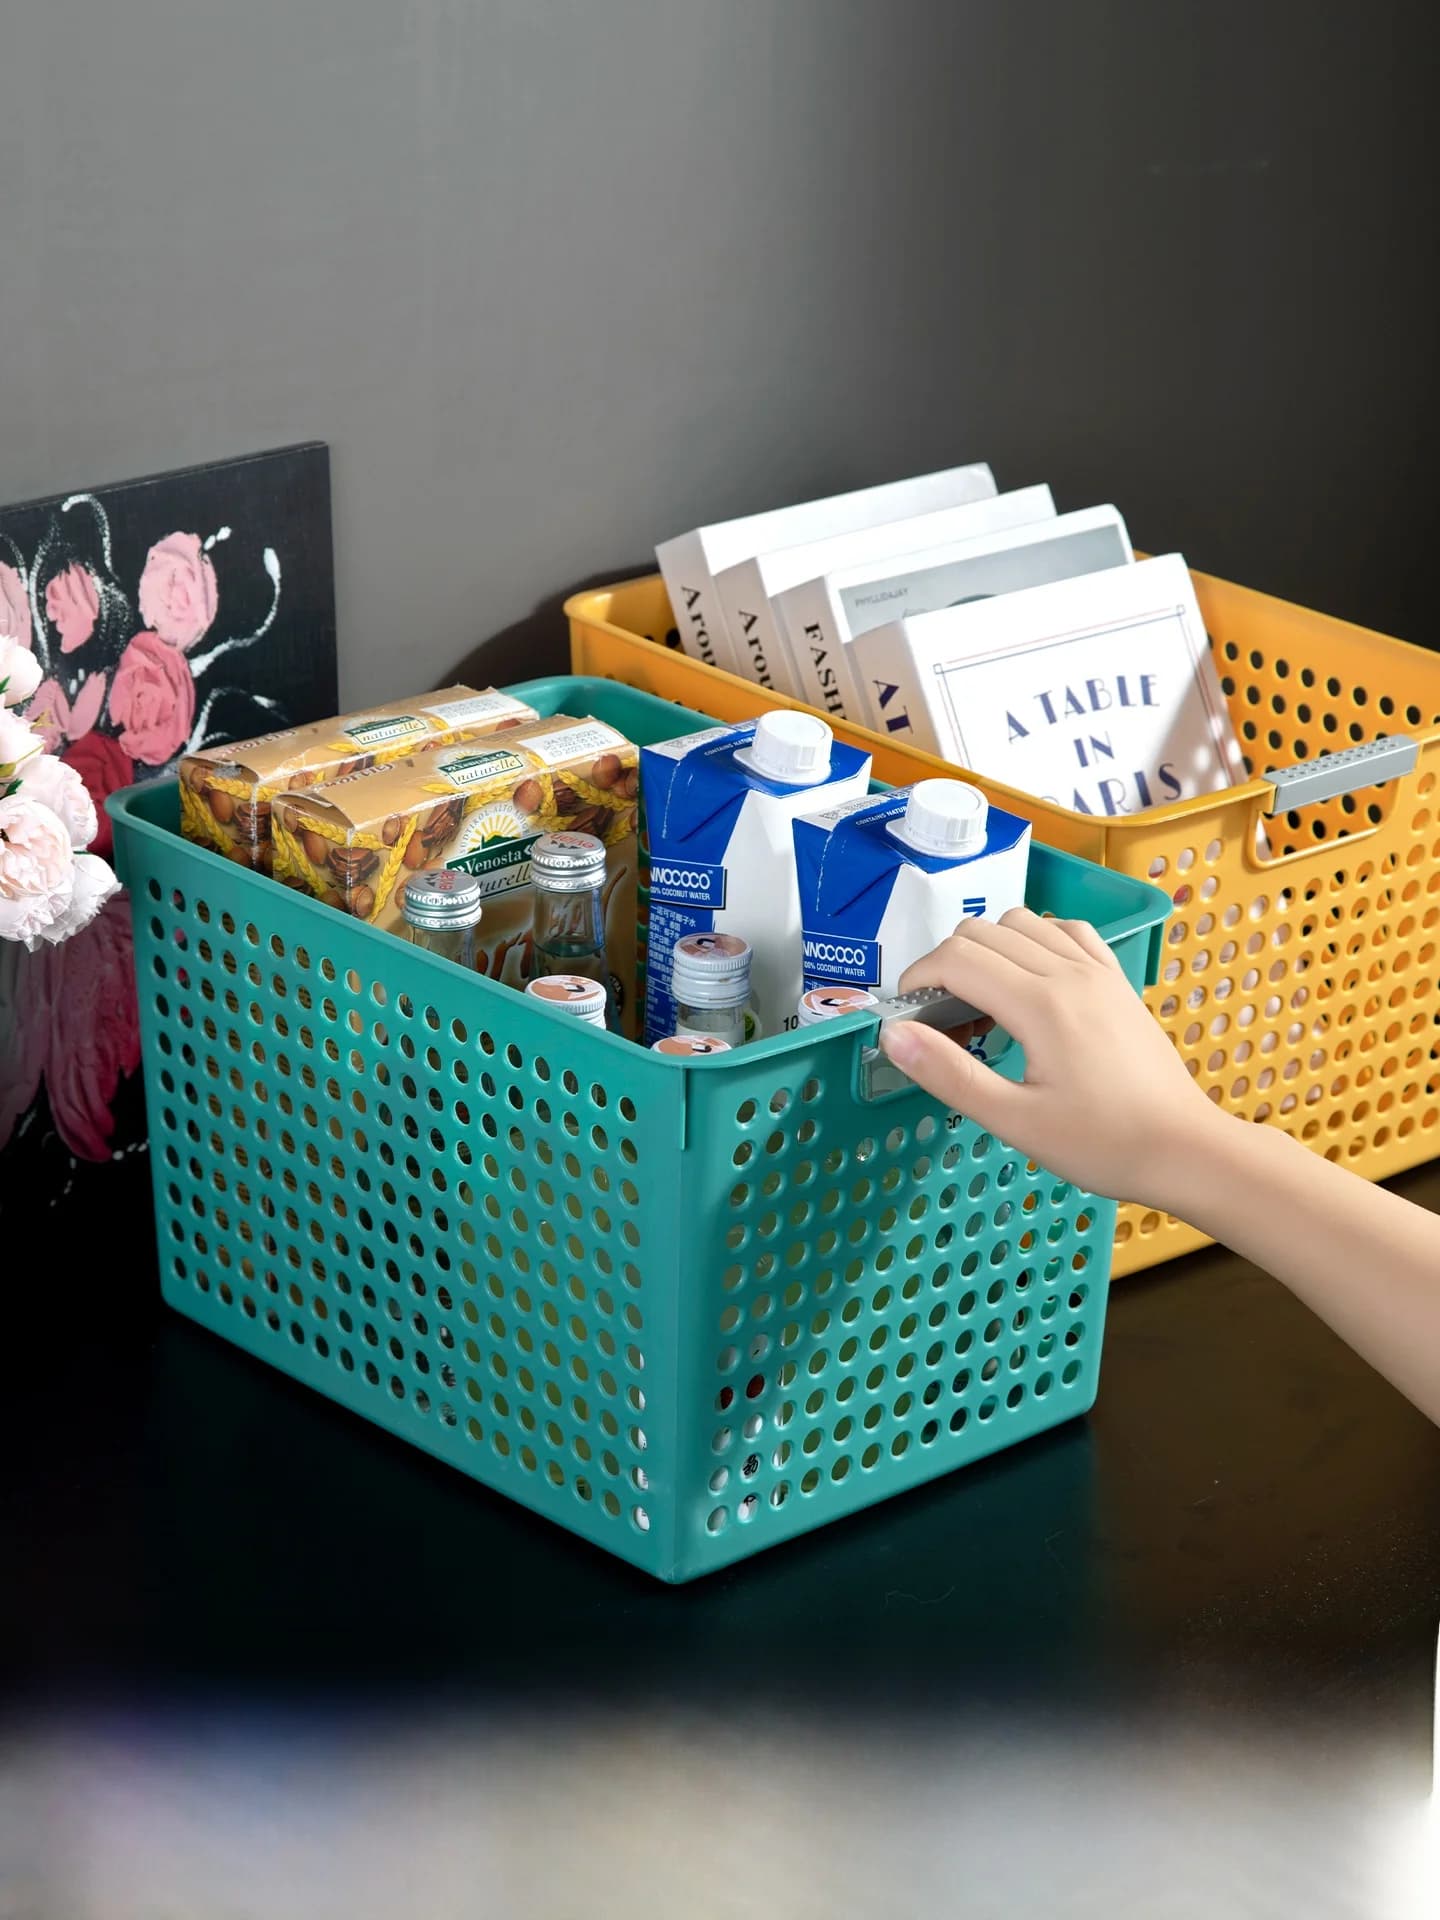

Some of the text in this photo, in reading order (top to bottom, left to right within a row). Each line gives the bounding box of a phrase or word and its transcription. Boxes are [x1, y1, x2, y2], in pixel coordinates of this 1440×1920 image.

[804, 621, 847, 720] FASH
[1005, 673, 1160, 745] A TABLE
[1073, 730, 1115, 768] IN
[456, 759, 516, 782] naturelle
[1040, 762, 1182, 816] ARIS
[465, 850, 522, 875] Venosta
[661, 888, 688, 898] COCONUT
[688, 891, 711, 901] WATER
[816, 962, 844, 974] COCONUT
[843, 967, 866, 977] WATER
